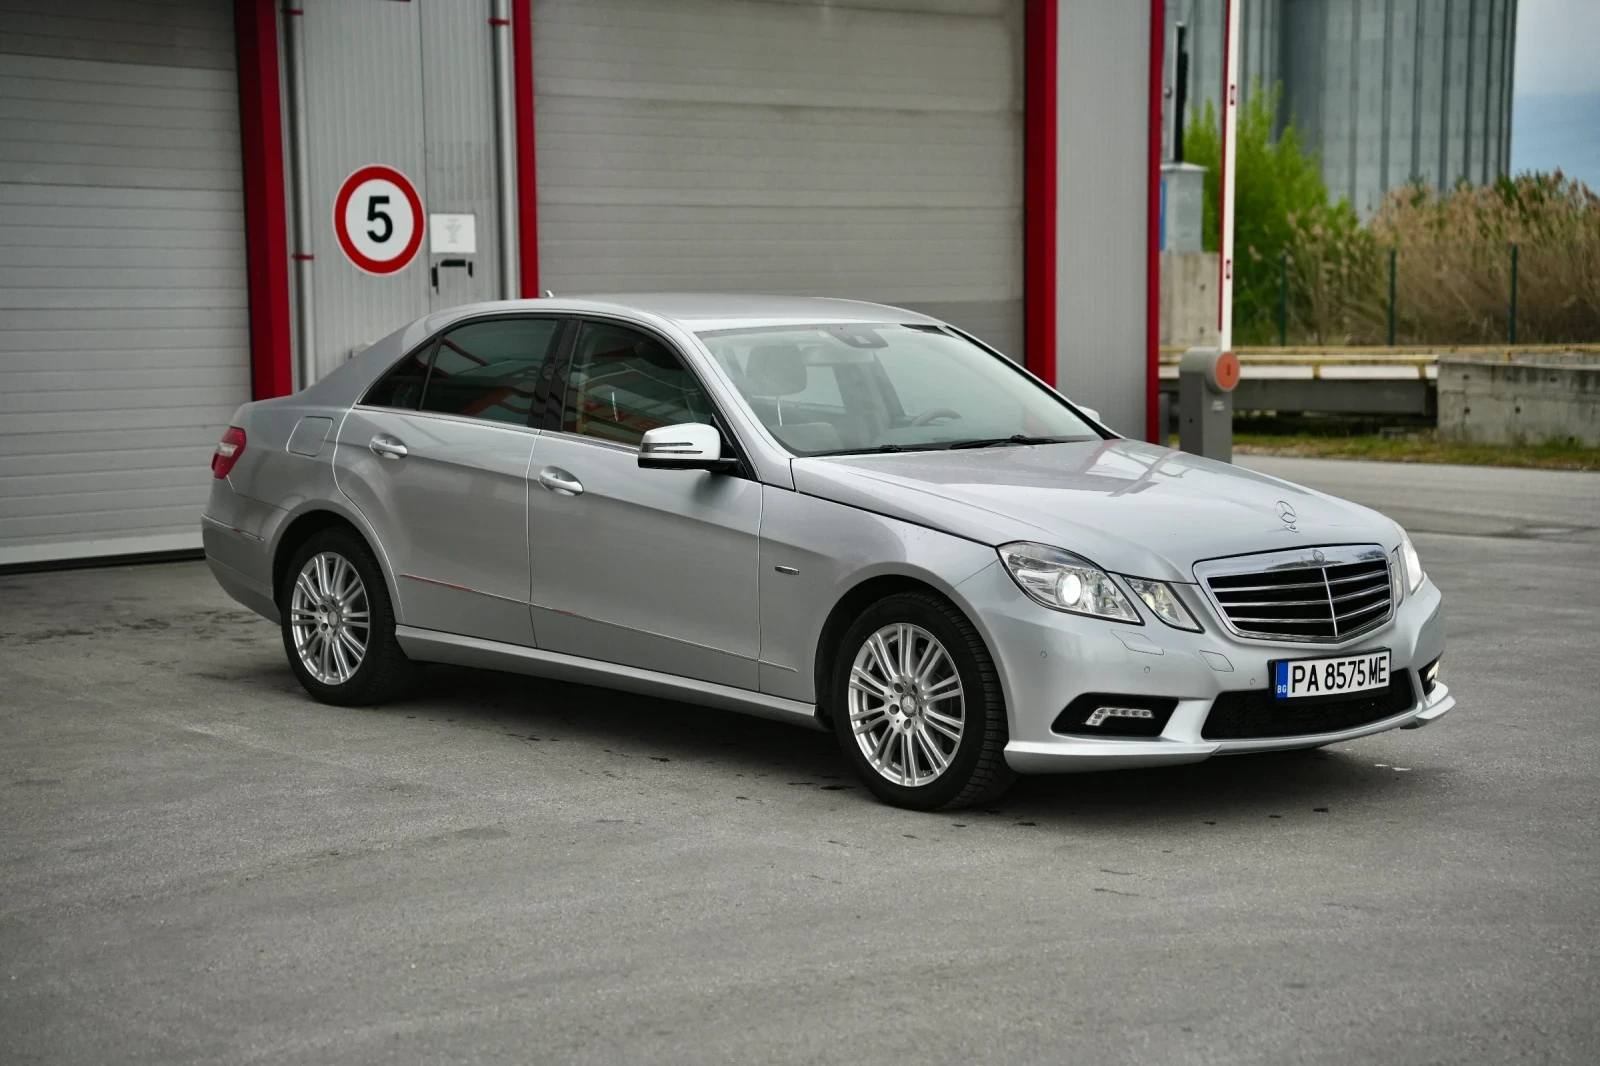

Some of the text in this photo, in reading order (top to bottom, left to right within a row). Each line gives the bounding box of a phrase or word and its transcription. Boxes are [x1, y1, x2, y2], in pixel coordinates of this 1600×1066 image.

[367, 196, 393, 243] 5
[1277, 685, 1287, 693] BG
[1292, 656, 1387, 693] PA 8575 ME
